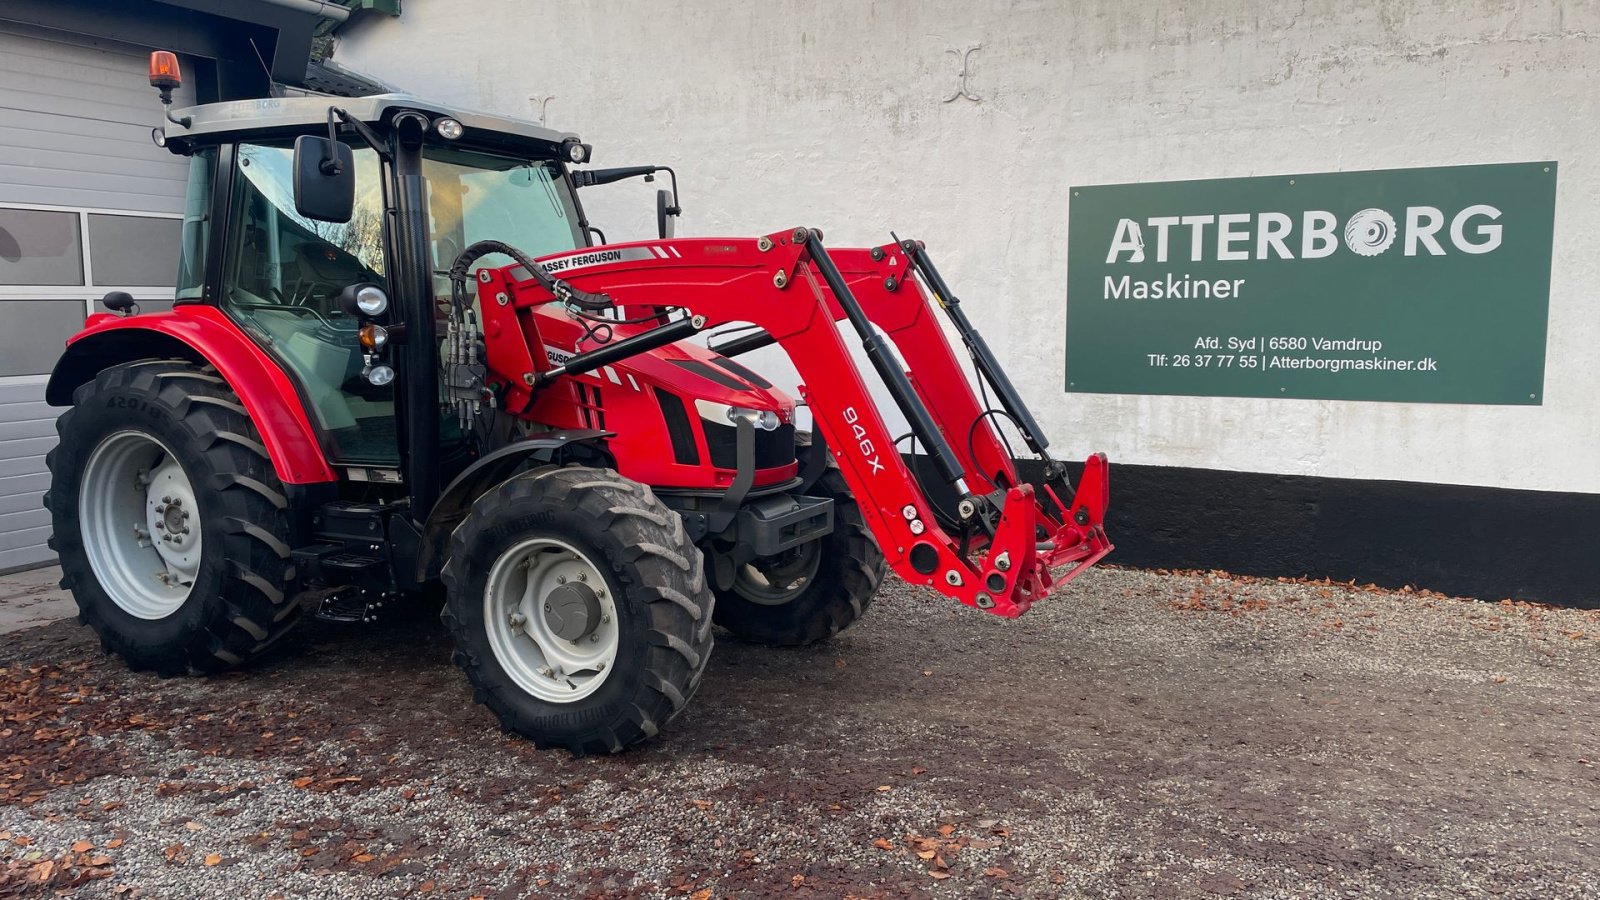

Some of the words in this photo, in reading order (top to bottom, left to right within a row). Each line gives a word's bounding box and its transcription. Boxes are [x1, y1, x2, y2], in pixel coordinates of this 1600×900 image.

[1105, 204, 1503, 264] ATTERBORG
[541, 260, 570, 273] ASSEY
[571, 250, 621, 266] FERGUSON
[1103, 273, 1246, 300] Maskiner
[1194, 337, 1223, 350] Afd.
[1227, 337, 1256, 352] Syd
[1269, 337, 1307, 350] 6580
[1312, 337, 1382, 354] Vamdrup
[1147, 354, 1169, 367] Tlf:
[1172, 354, 1191, 368] 26
[1194, 355, 1212, 368] 37
[1217, 355, 1235, 368] 77
[1239, 355, 1258, 368] 55
[1269, 355, 1438, 373] Atterborgmaskiner.dk
[842, 406, 886, 476] 946X
